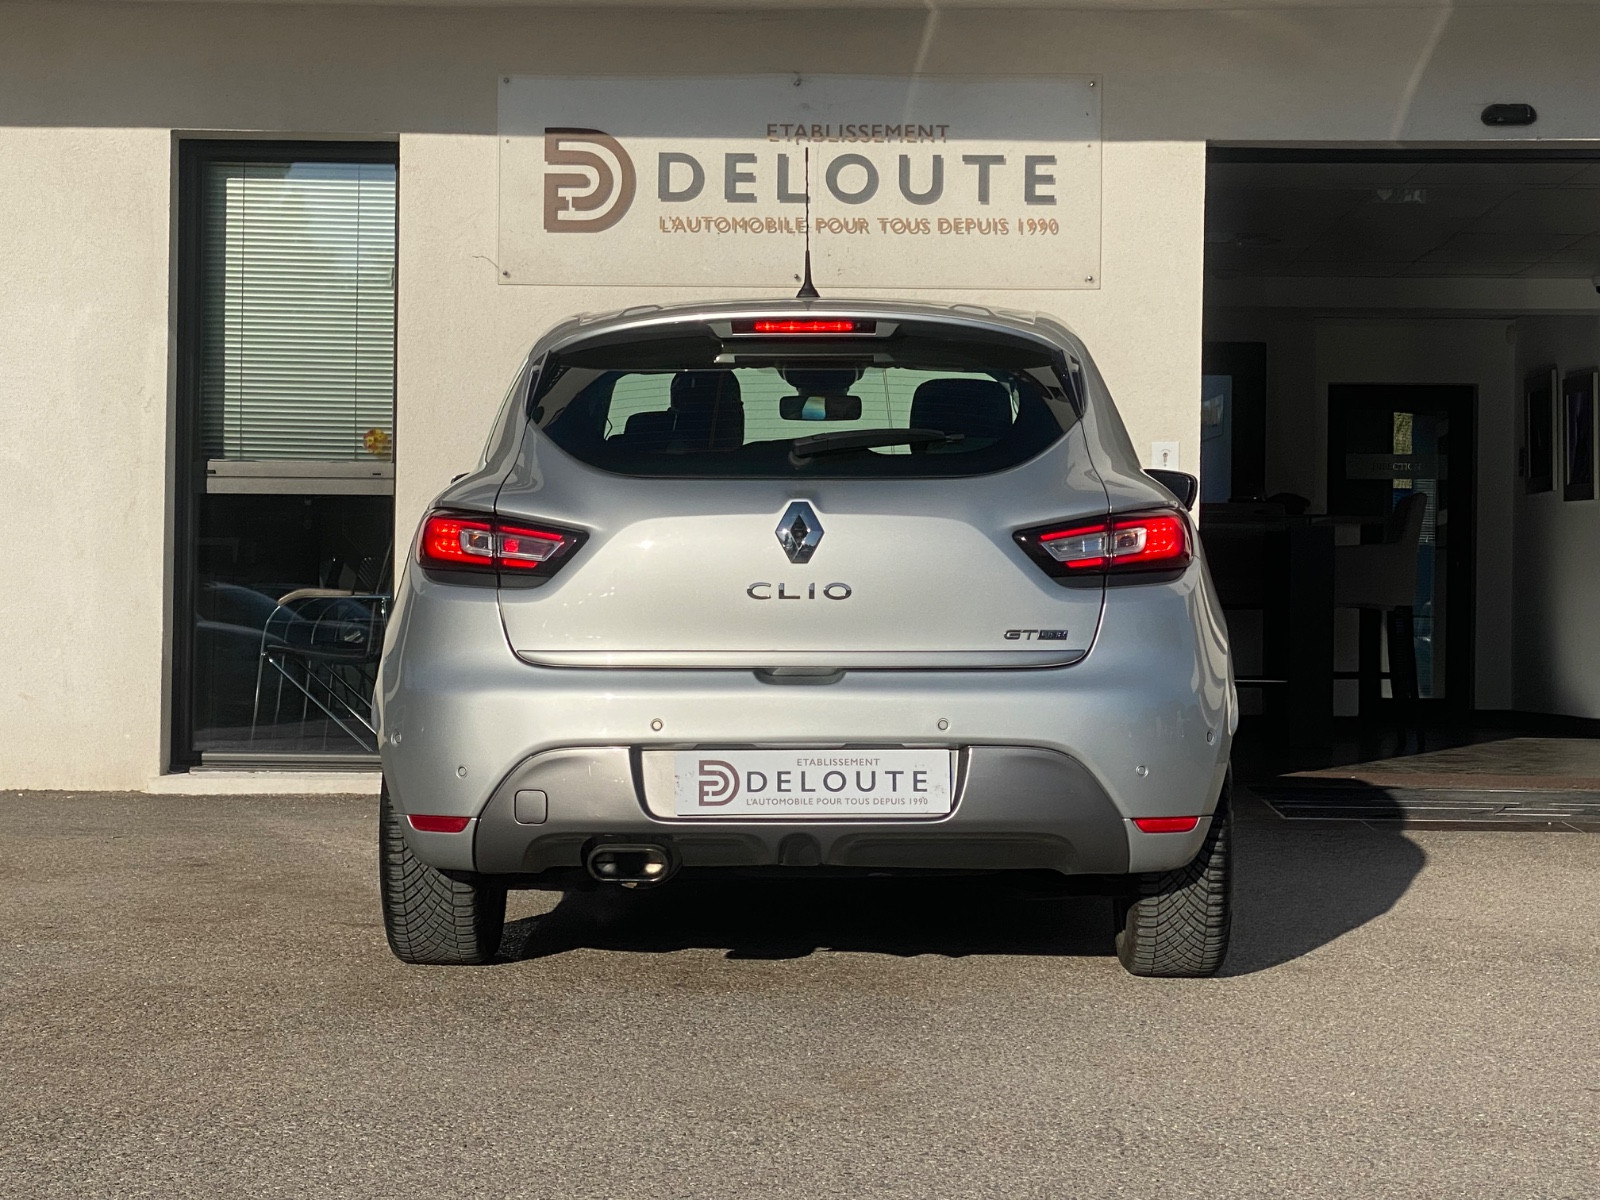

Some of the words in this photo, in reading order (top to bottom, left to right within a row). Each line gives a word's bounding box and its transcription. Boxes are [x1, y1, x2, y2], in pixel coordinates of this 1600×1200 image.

[766, 123, 950, 142] ETABLISSEMENT
[657, 152, 1058, 205] DELOUTE
[659, 216, 808, 234] L'AUTOMOBILE
[815, 217, 870, 234] POUR
[877, 217, 931, 235] TOUS
[937, 217, 1009, 235] DEPUIS
[1017, 217, 1060, 236] 1990
[746, 582, 852, 600] CLIO
[796, 758, 881, 767] ETABLISSEMENT
[746, 770, 929, 793] DELOUTE
[746, 797, 813, 806] L'AUTOMOBILE
[816, 797, 842, 806] POUR
[845, 797, 870, 806] TOUS
[872, 797, 906, 806] DEPUIS
